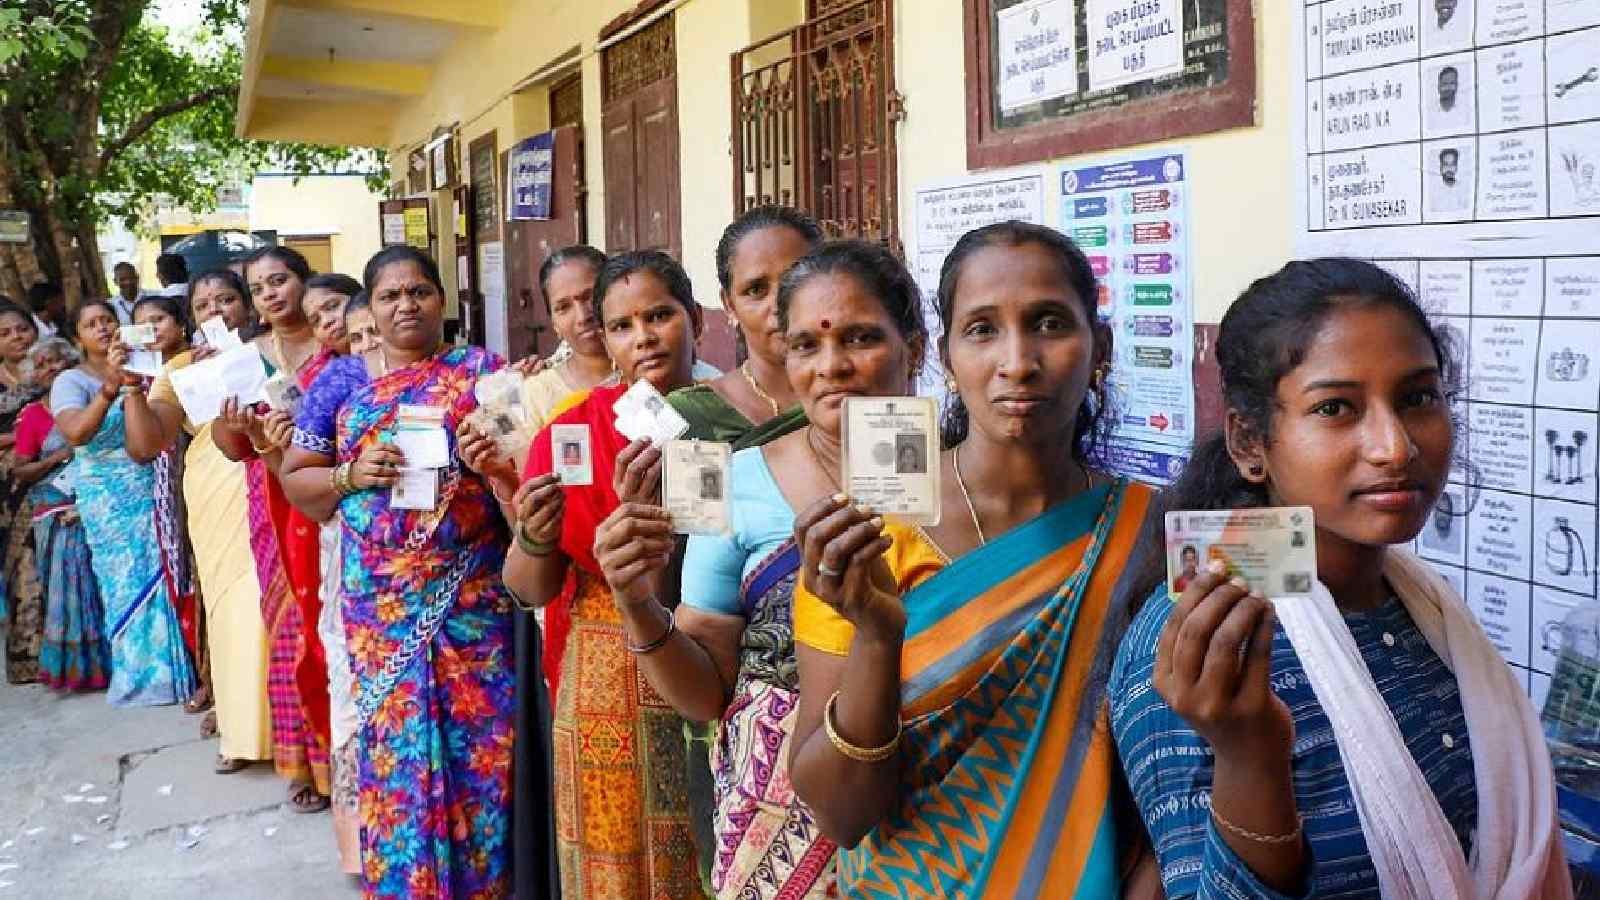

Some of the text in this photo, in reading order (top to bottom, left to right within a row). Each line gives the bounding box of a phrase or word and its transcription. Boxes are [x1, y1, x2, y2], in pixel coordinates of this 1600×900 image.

[1326, 26, 1416, 57] TAMILAN PRASANNA
[1327, 117, 1350, 135] ARUN
[1352, 199, 1407, 220] GUNASEKAR
